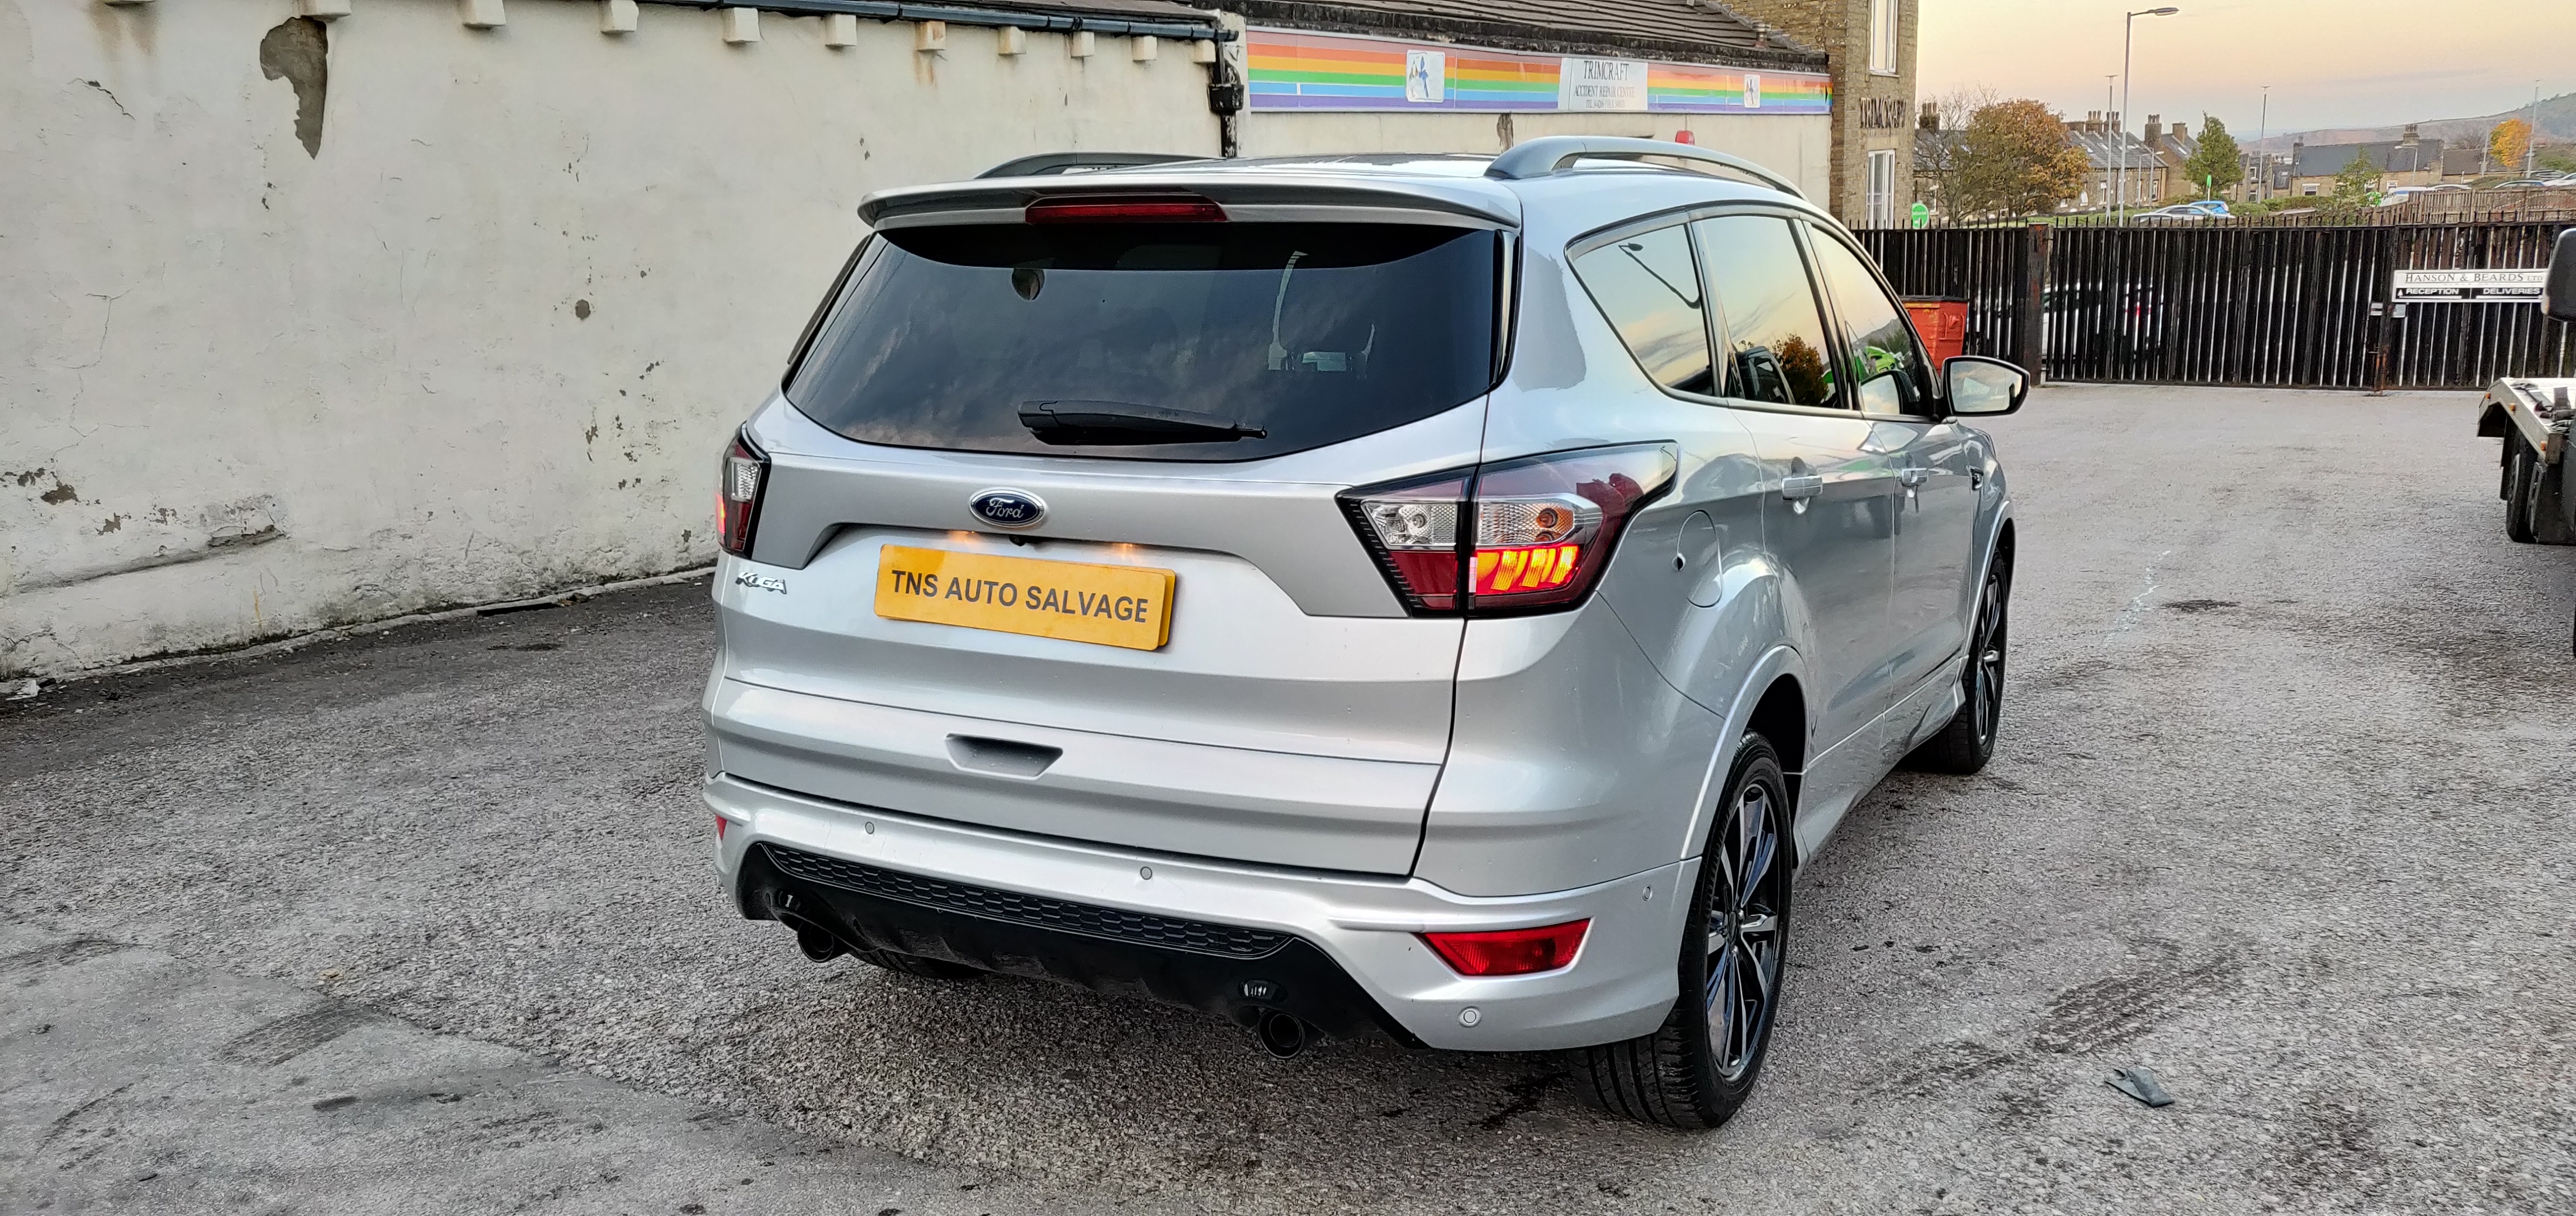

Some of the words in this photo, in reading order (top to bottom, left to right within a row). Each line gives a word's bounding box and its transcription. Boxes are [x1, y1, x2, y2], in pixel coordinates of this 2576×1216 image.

[1584, 60, 1629, 80] TRIMCRAFT
[1575, 85, 1598, 97] ACCIDENT
[1599, 86, 1616, 97] REPAIR
[1617, 86, 1635, 97] CENTRE
[2405, 273, 2455, 282] HANSON
[2474, 273, 2523, 282] BEARDS
[986, 497, 1025, 519] Ford
[735, 572, 787, 595] KUGA
[891, 569, 939, 597] TNS
[944, 577, 1018, 607] AUTO
[1025, 585, 1149, 623] SALVAGE
